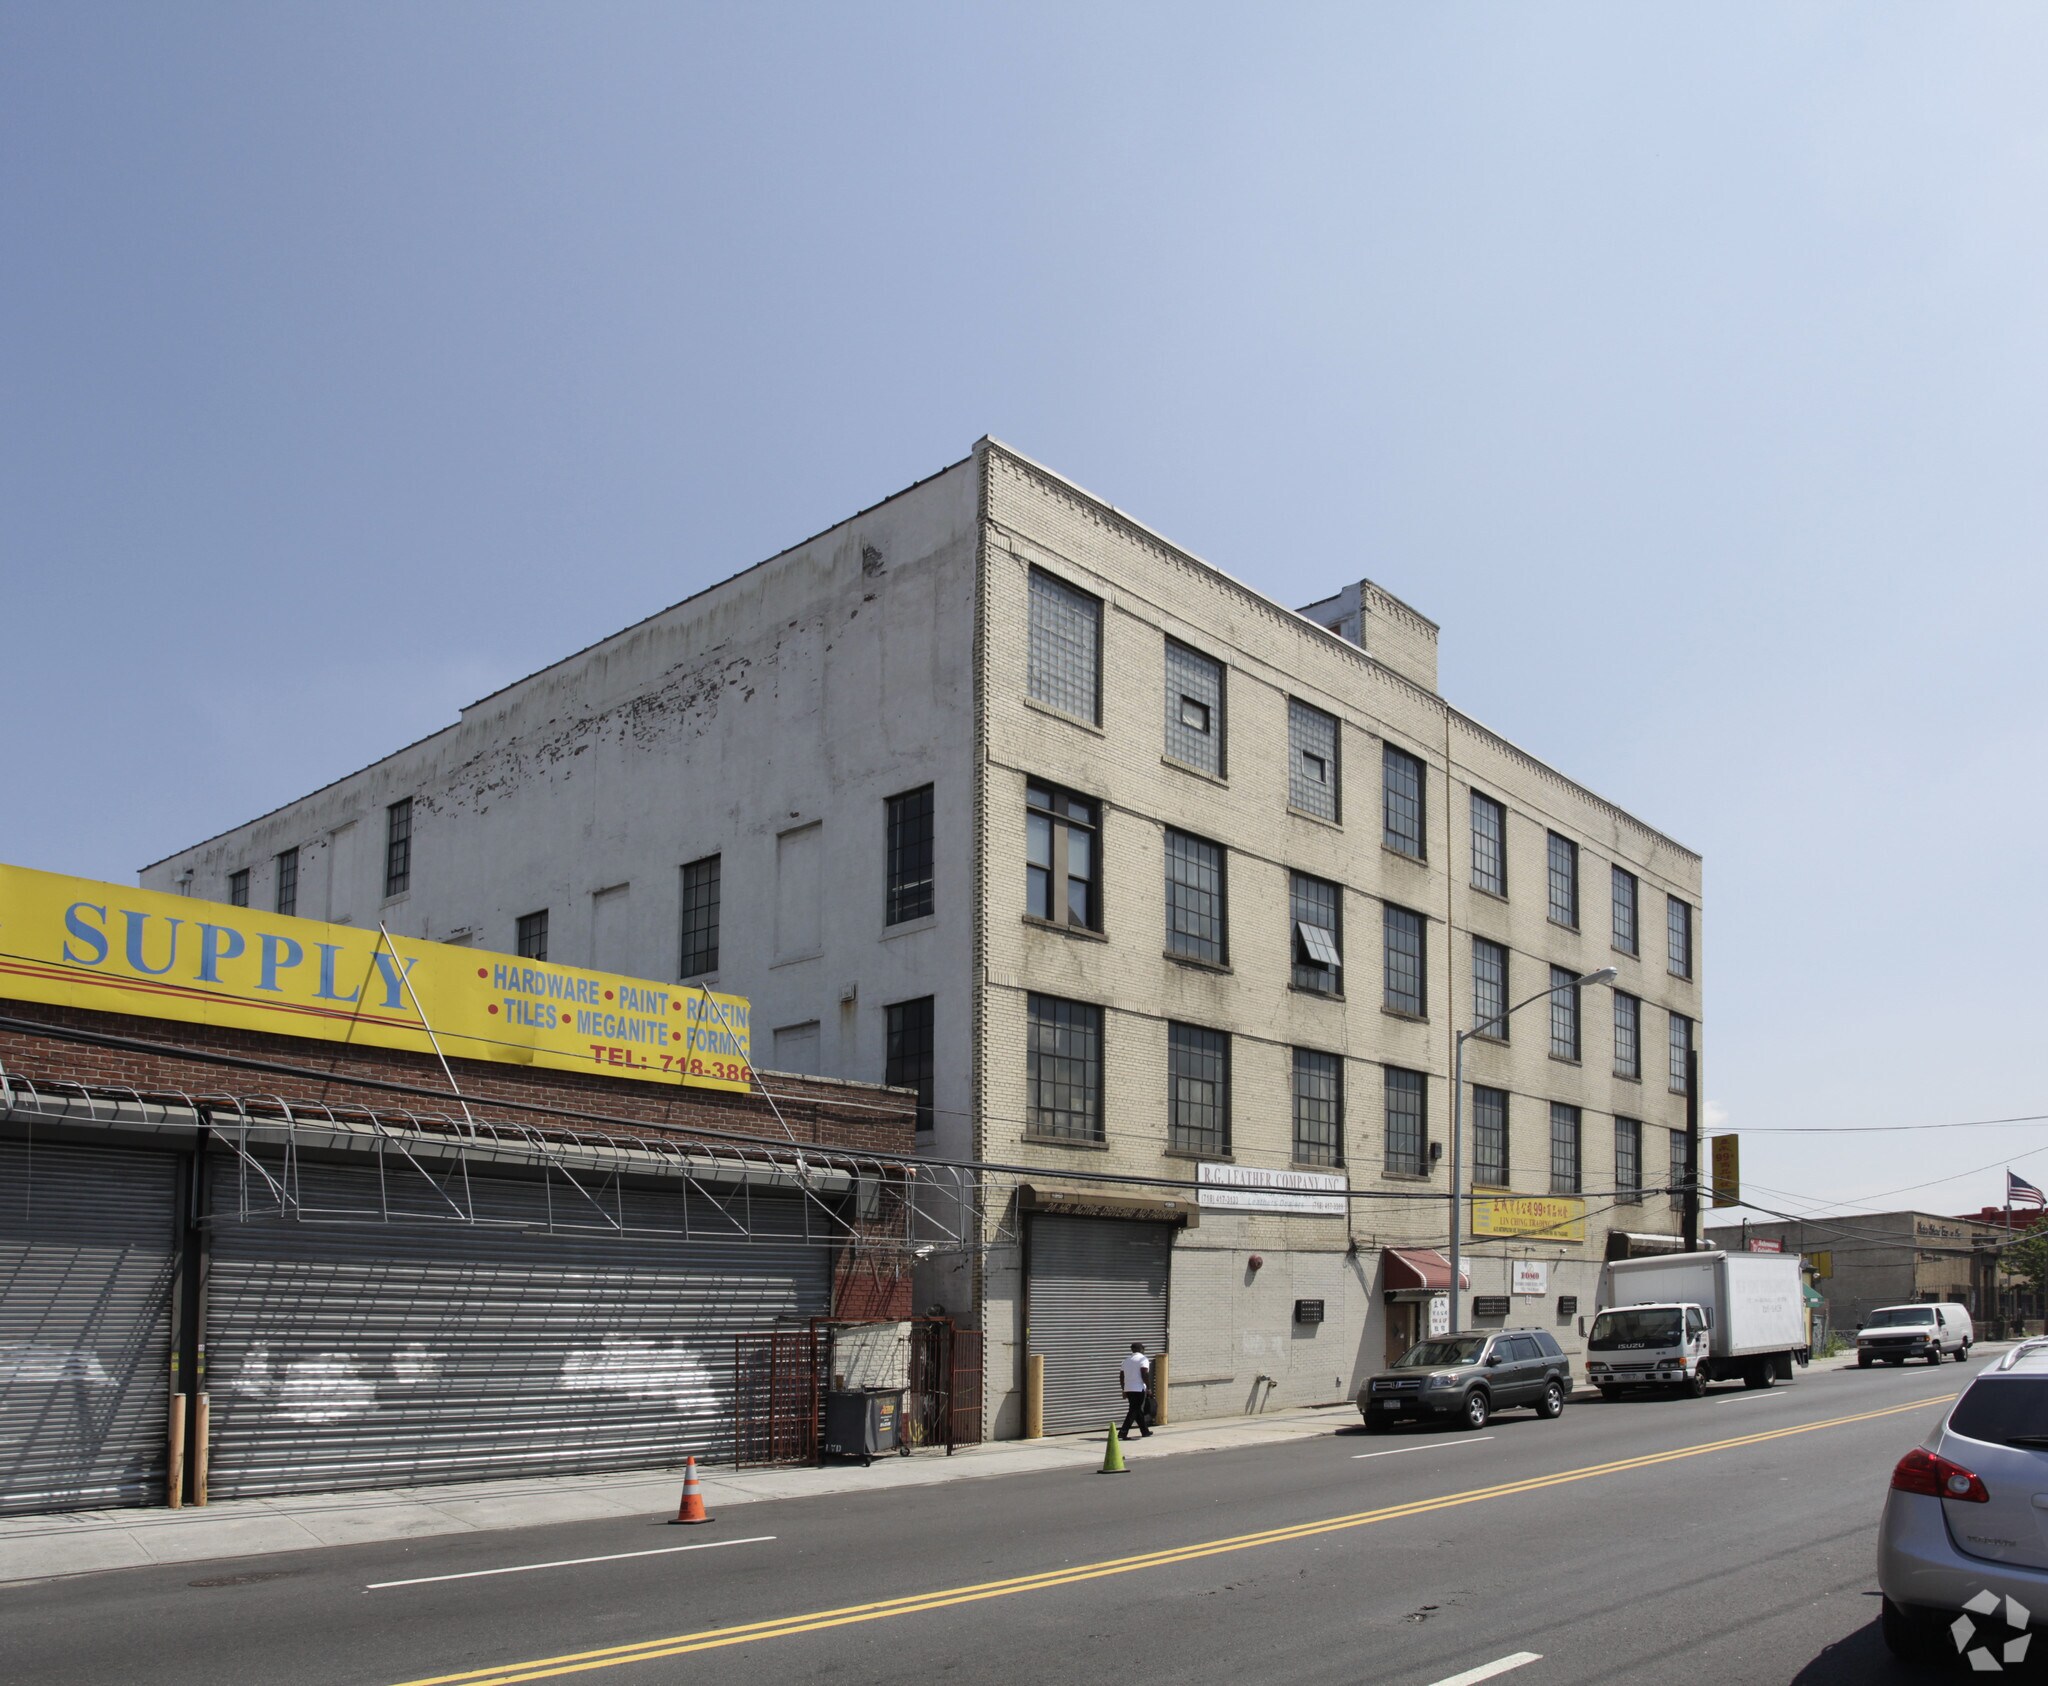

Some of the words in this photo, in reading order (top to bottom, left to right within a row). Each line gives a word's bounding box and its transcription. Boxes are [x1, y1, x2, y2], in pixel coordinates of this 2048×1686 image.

[62, 902, 419, 1010] SUPPLY
[493, 964, 600, 1005] HARDWARE
[619, 985, 669, 1016] PAINT
[503, 998, 557, 1030] TILES
[577, 1009, 668, 1047] MEGANITE
[686, 1027, 751, 1058] FORMIC
[589, 1044, 648, 1070] TEL:
[1204, 1167, 1224, 1184] R.G.
[1227, 1169, 1271, 1187] LEATHER
